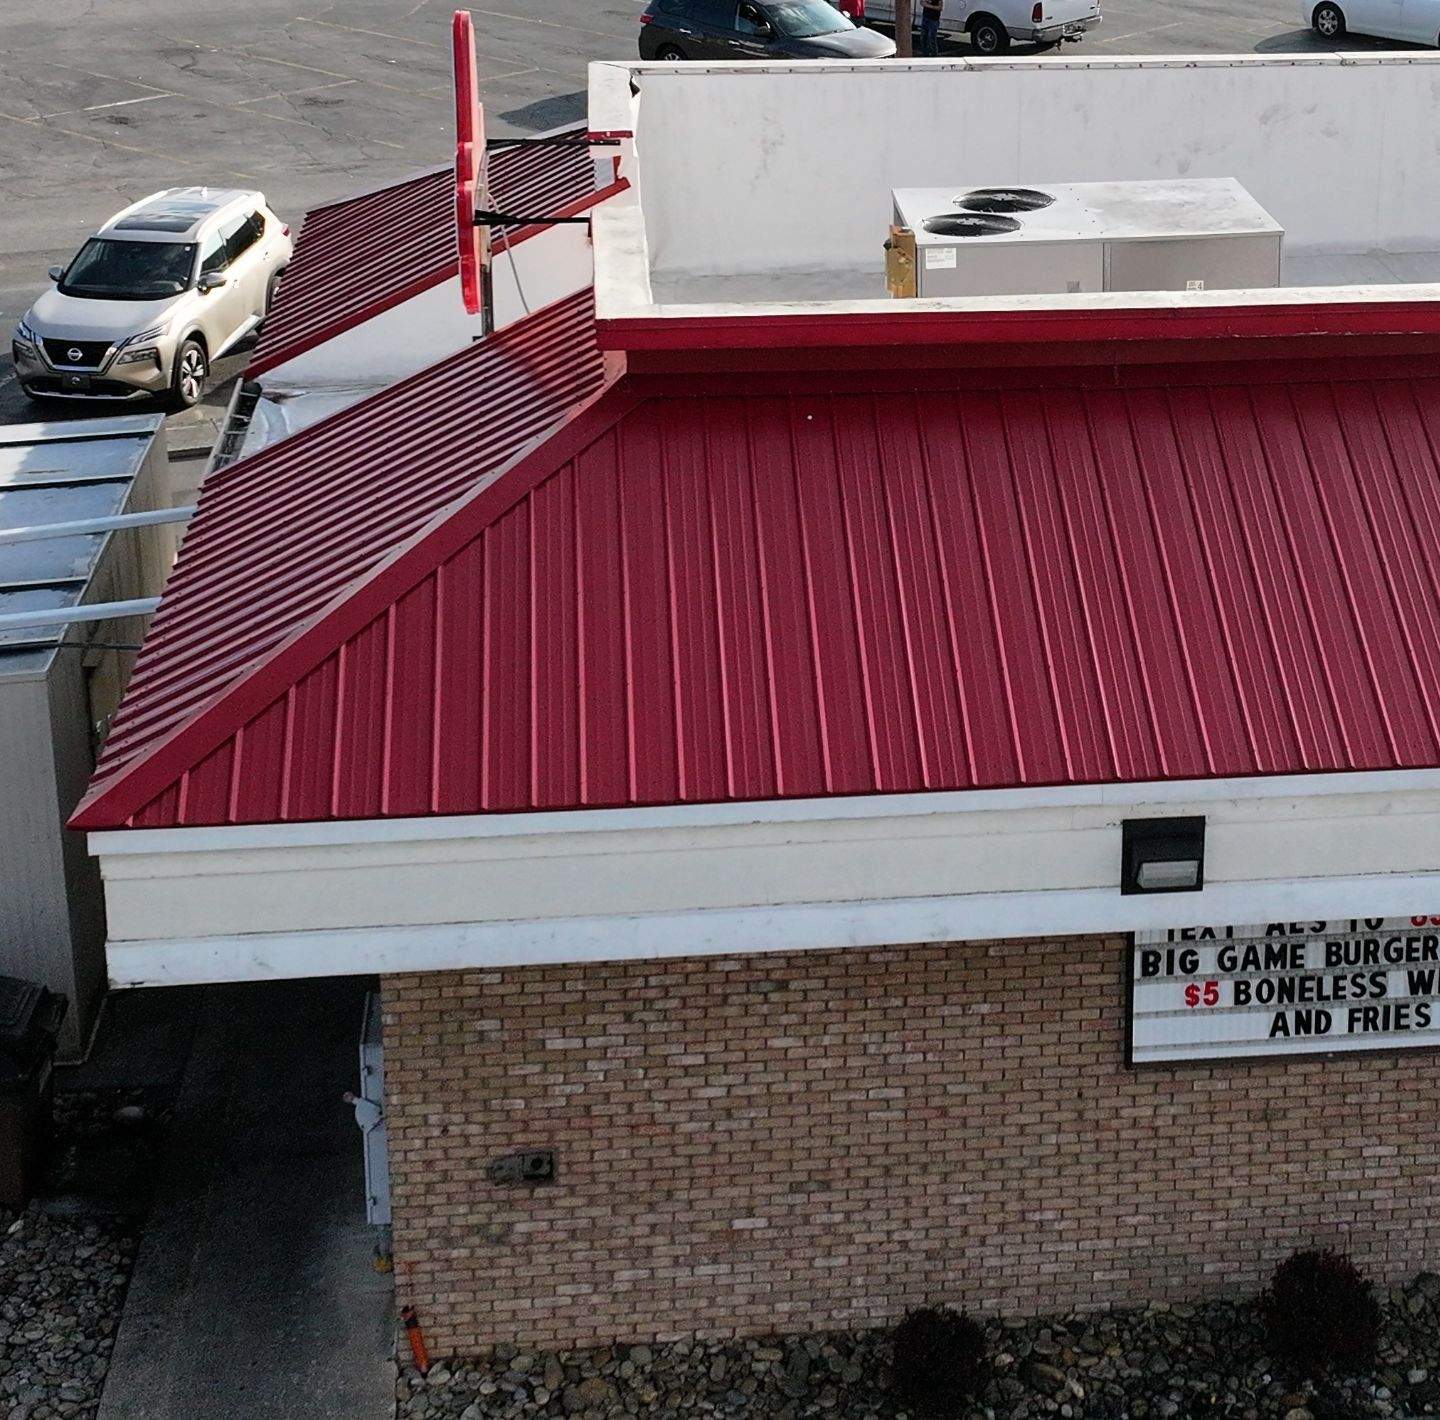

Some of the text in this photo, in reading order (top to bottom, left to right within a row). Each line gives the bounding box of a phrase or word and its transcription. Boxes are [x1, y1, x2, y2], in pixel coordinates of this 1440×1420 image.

[1140, 934, 1440, 977] BIG GAME BURGER
[1184, 980, 1220, 1009] $5
[1234, 971, 1388, 1007] BONELESS
[1269, 1003, 1432, 1038] AND FRIES
